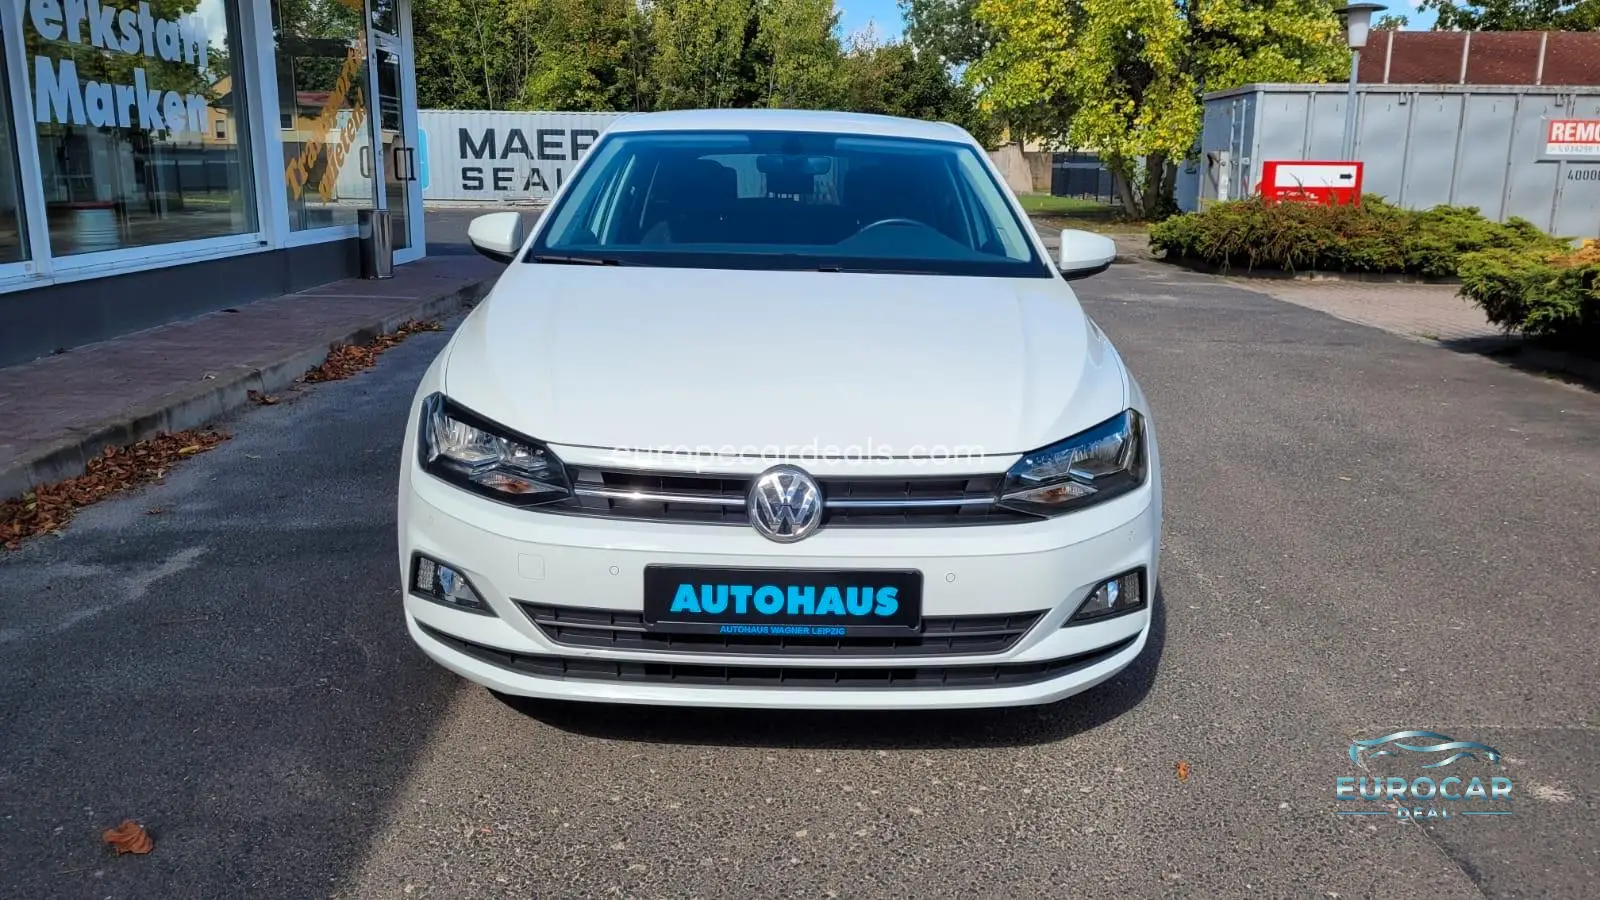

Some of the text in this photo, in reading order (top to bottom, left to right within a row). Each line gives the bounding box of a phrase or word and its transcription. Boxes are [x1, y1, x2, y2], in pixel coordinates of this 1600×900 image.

[23, 0, 209, 68] erkstatt
[35, 56, 208, 133] Marken
[458, 127, 600, 161] MAER
[670, 583, 898, 616] AUTOHAUS
[720, 625, 846, 636] AUTOHAUS WAGNER LEIPZIG
